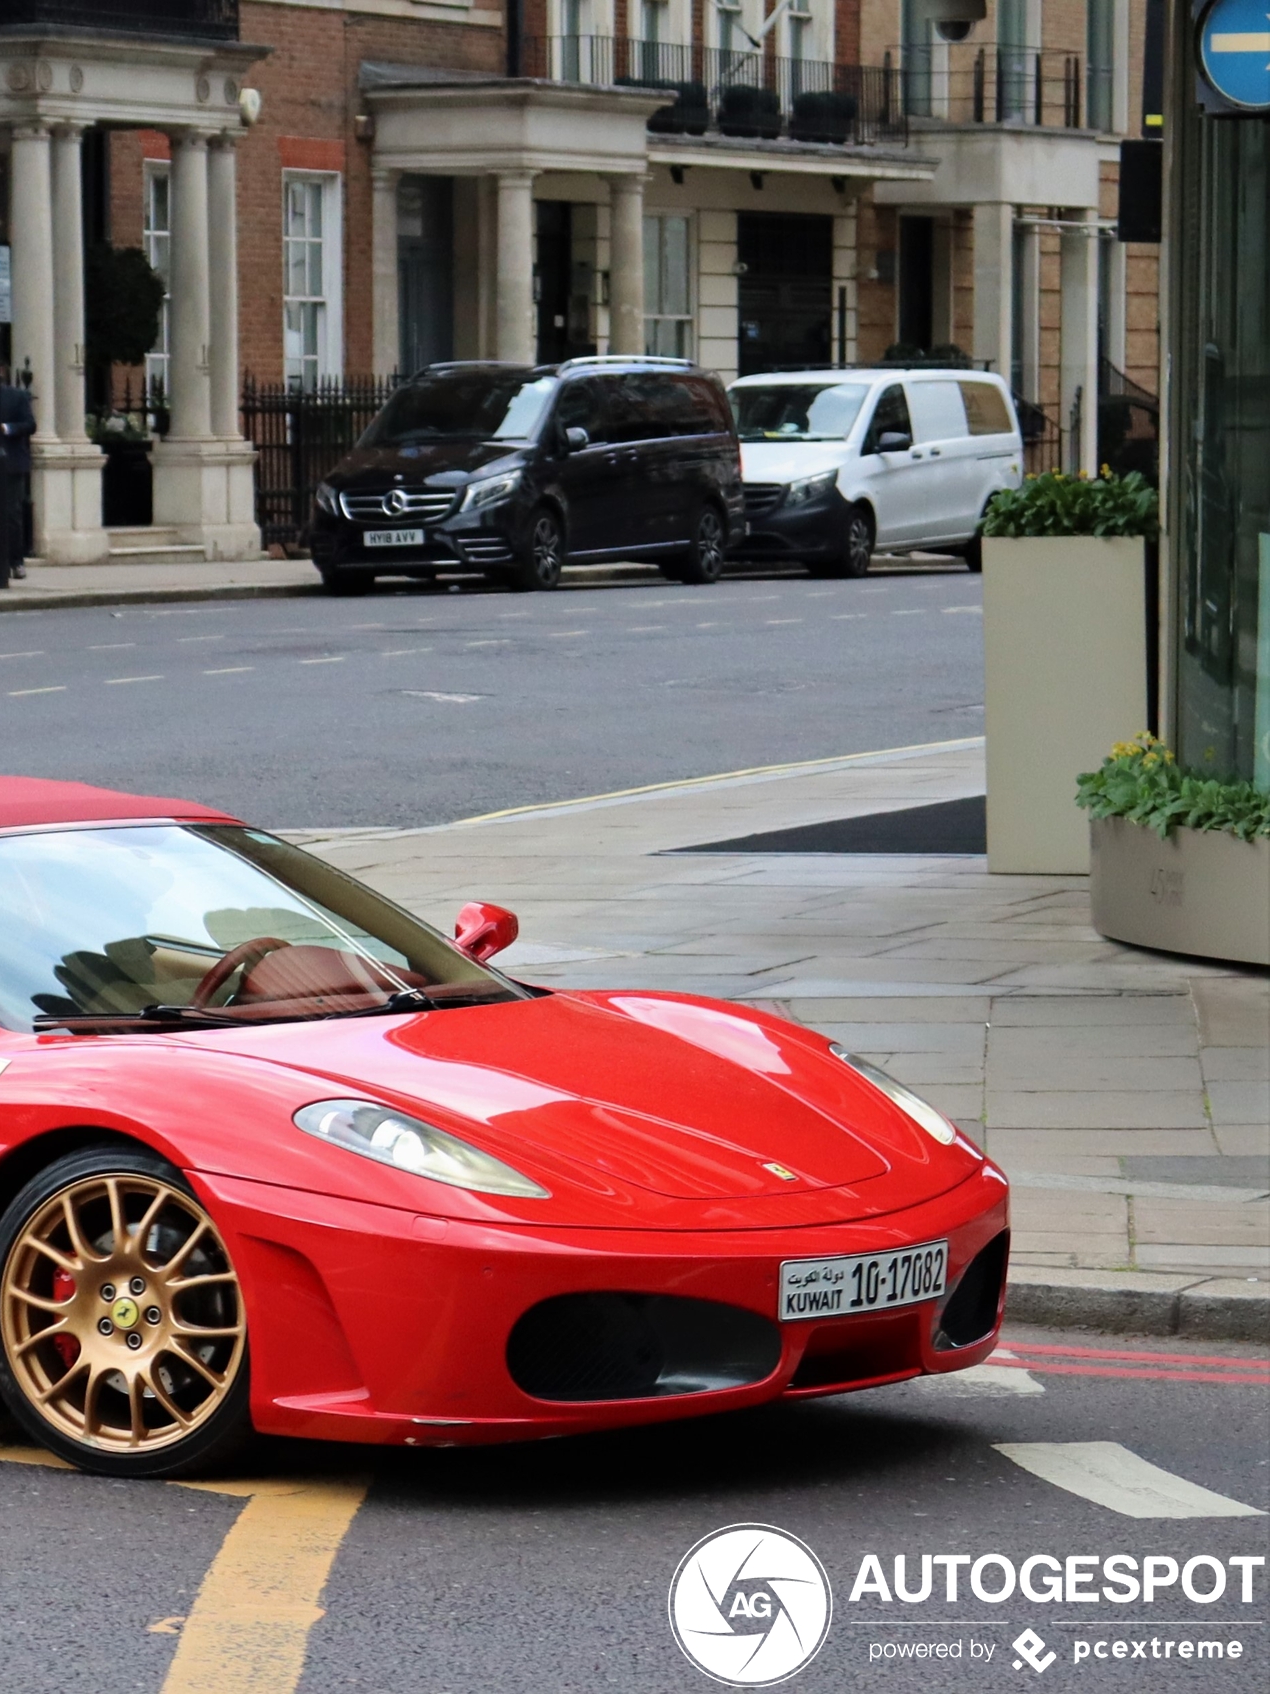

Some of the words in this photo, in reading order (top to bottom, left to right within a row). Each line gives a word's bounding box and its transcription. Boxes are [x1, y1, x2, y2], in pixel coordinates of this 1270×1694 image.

[369, 532, 392, 544] HY18
[396, 531, 415, 542] AVV
[787, 1270, 820, 1289] الكويت
[822, 1266, 845, 1285] دولة
[850, 1248, 944, 1307] 10-17082
[786, 1289, 843, 1314] KUWAIT
